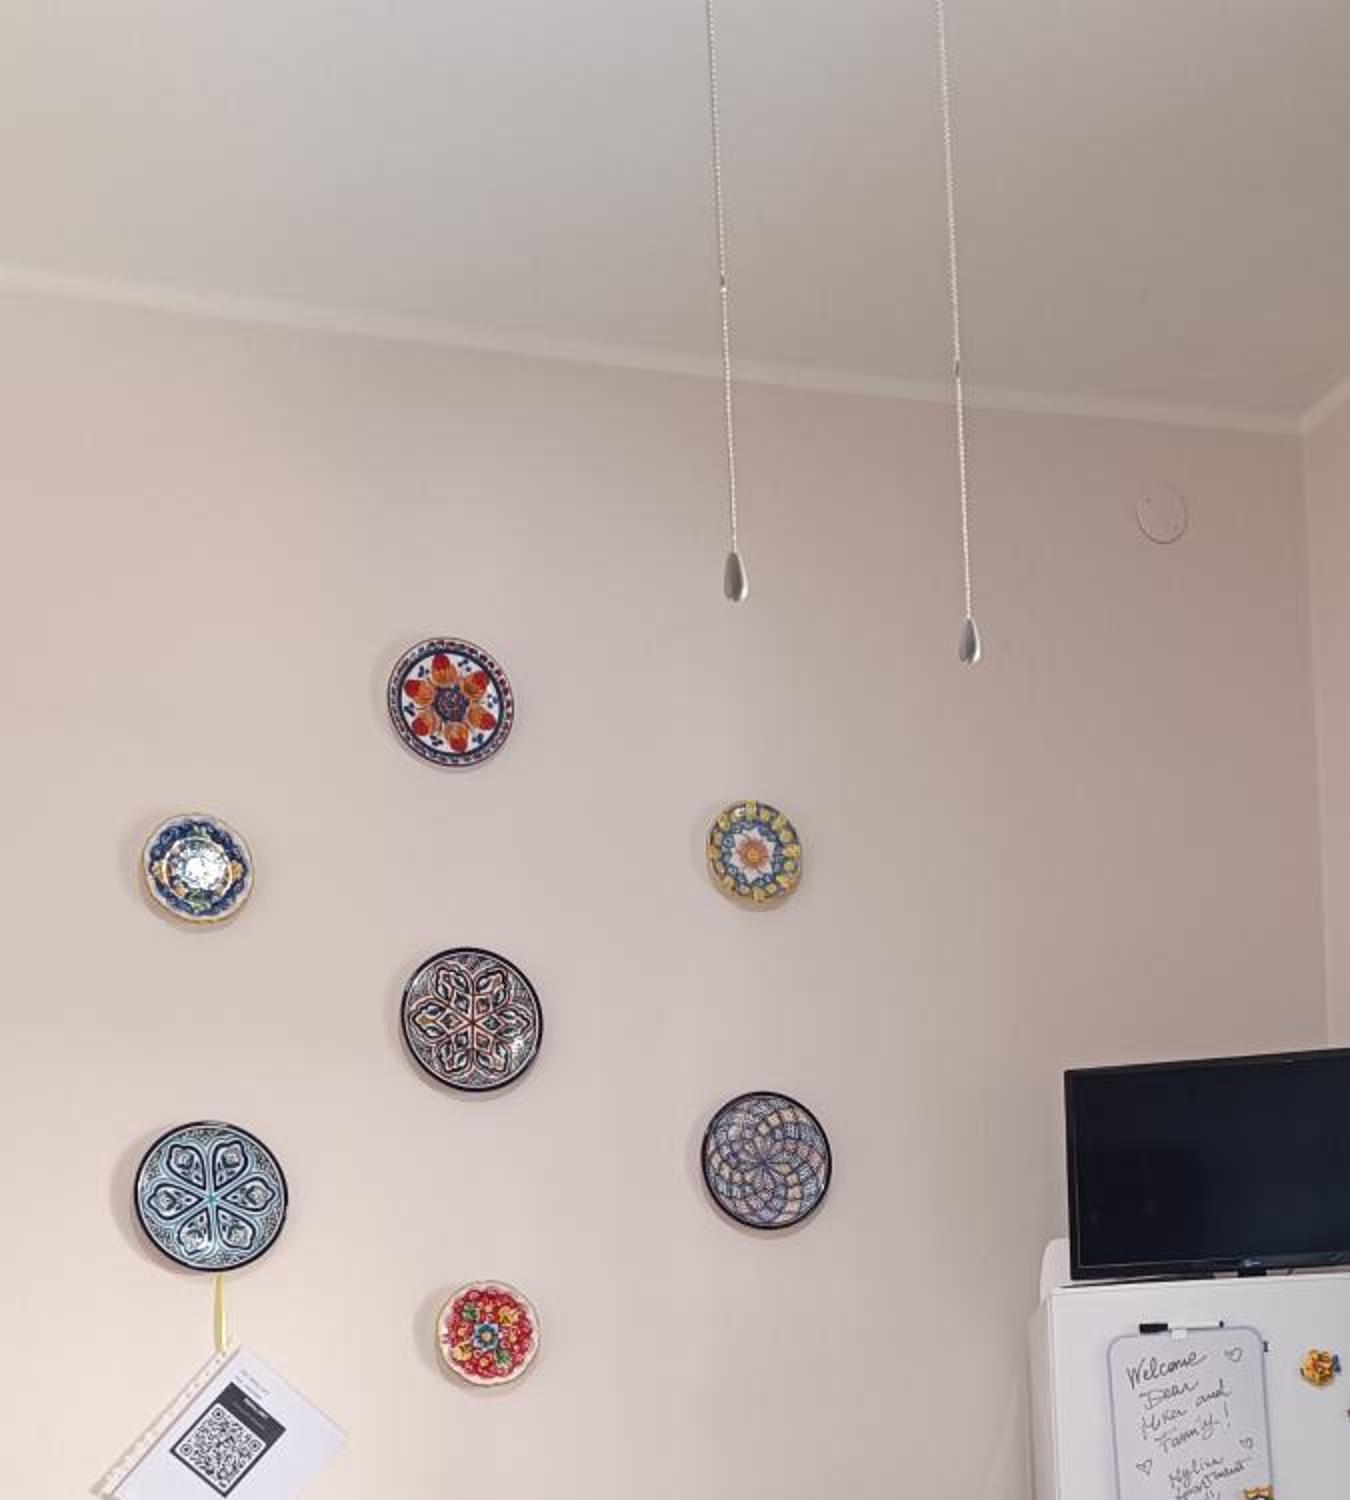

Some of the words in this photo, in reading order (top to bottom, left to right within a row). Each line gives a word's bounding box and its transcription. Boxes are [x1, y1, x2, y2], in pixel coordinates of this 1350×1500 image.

[1126, 1351, 1207, 1390] Welcome
[1139, 1381, 1198, 1411] Dear
[1195, 1377, 1232, 1408] and
